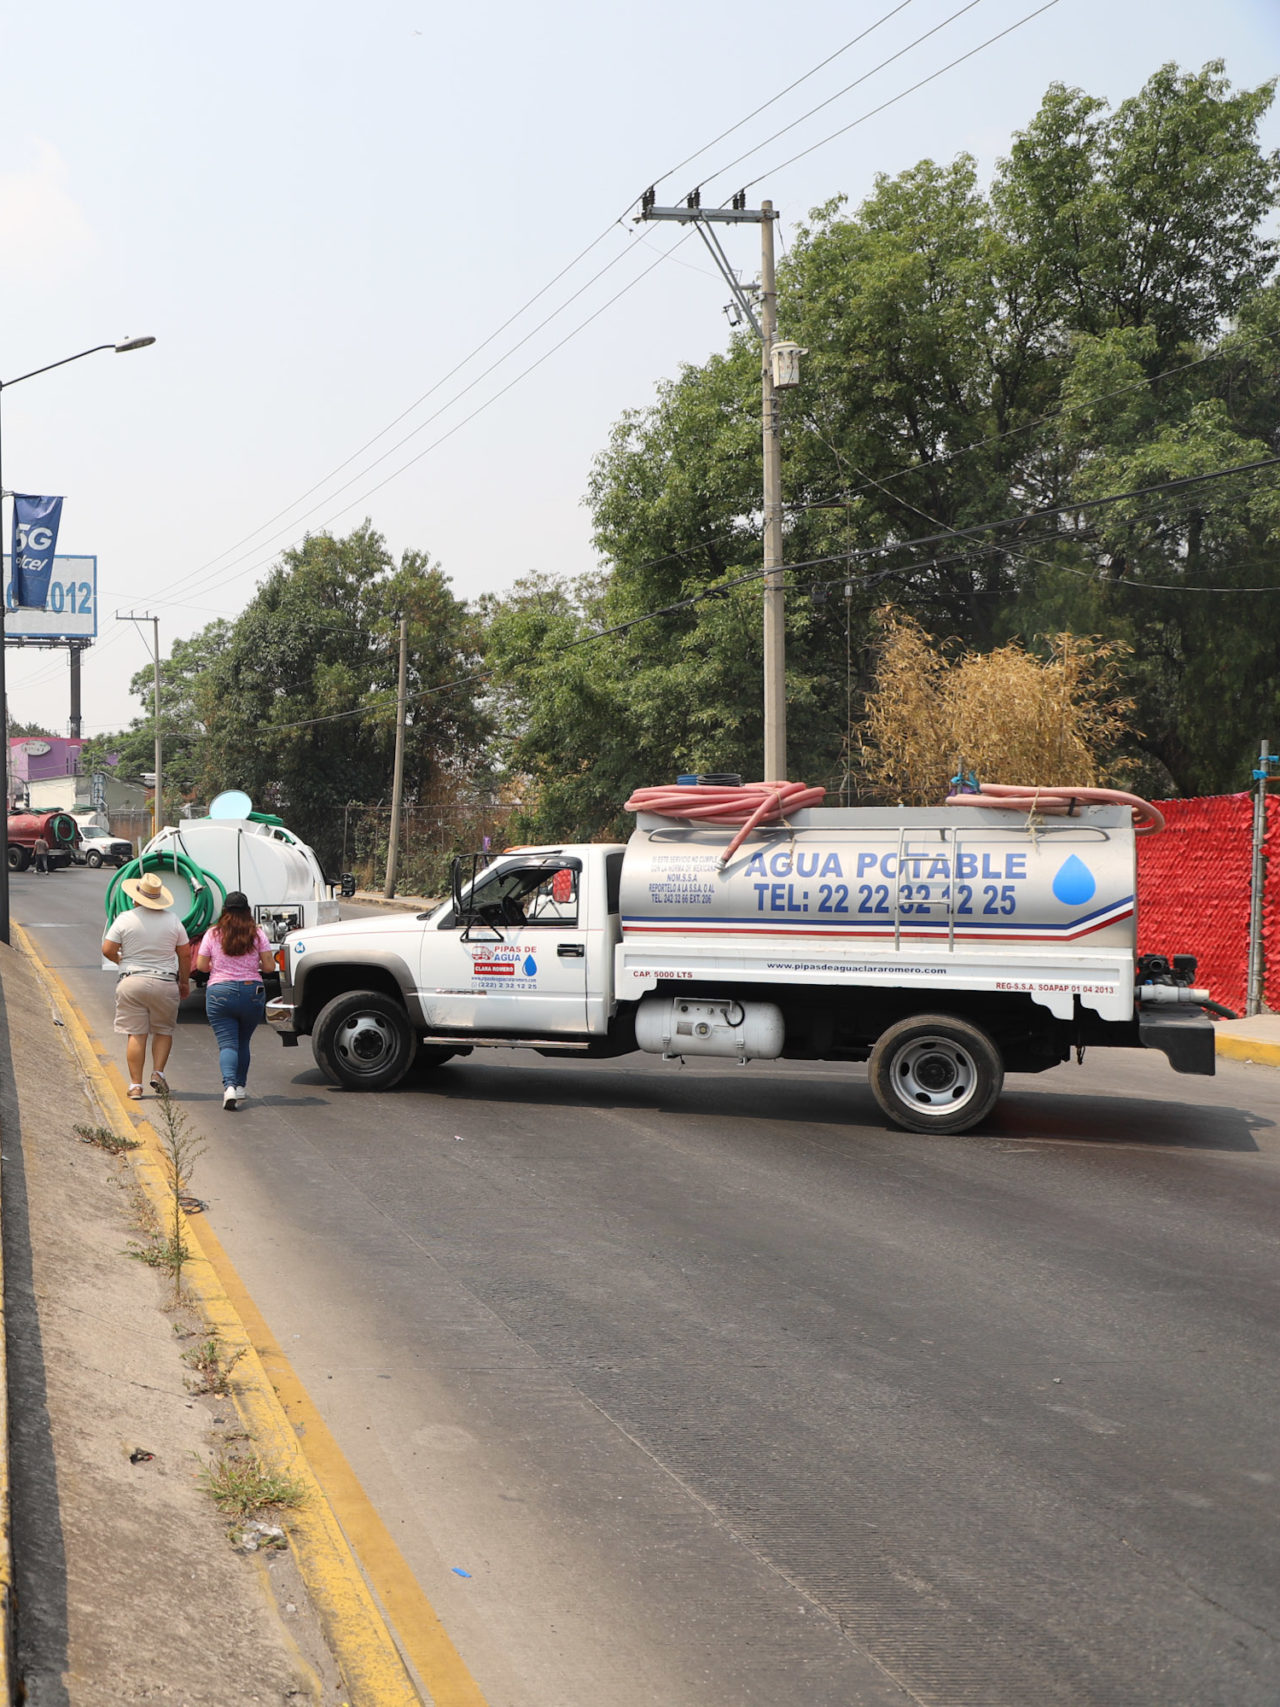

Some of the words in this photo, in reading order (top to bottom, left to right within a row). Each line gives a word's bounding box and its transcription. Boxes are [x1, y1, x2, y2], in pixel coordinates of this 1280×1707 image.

[744, 853, 843, 878] AGUA
[856, 853, 1027, 880] POTABLE
[754, 884, 809, 912] TEL:
[818, 884, 849, 913] 22
[858, 884, 889, 914] 22
[899, 884, 931, 914] 32
[982, 885, 1016, 915] 25
[494, 953, 521, 961] AGUA
[767, 962, 947, 974] www.pipasdeaguaclararomero.com
[633, 970, 651, 978] CAP.
[677, 971, 693, 979] LTS
[1038, 984, 1070, 992] SOAPAP
